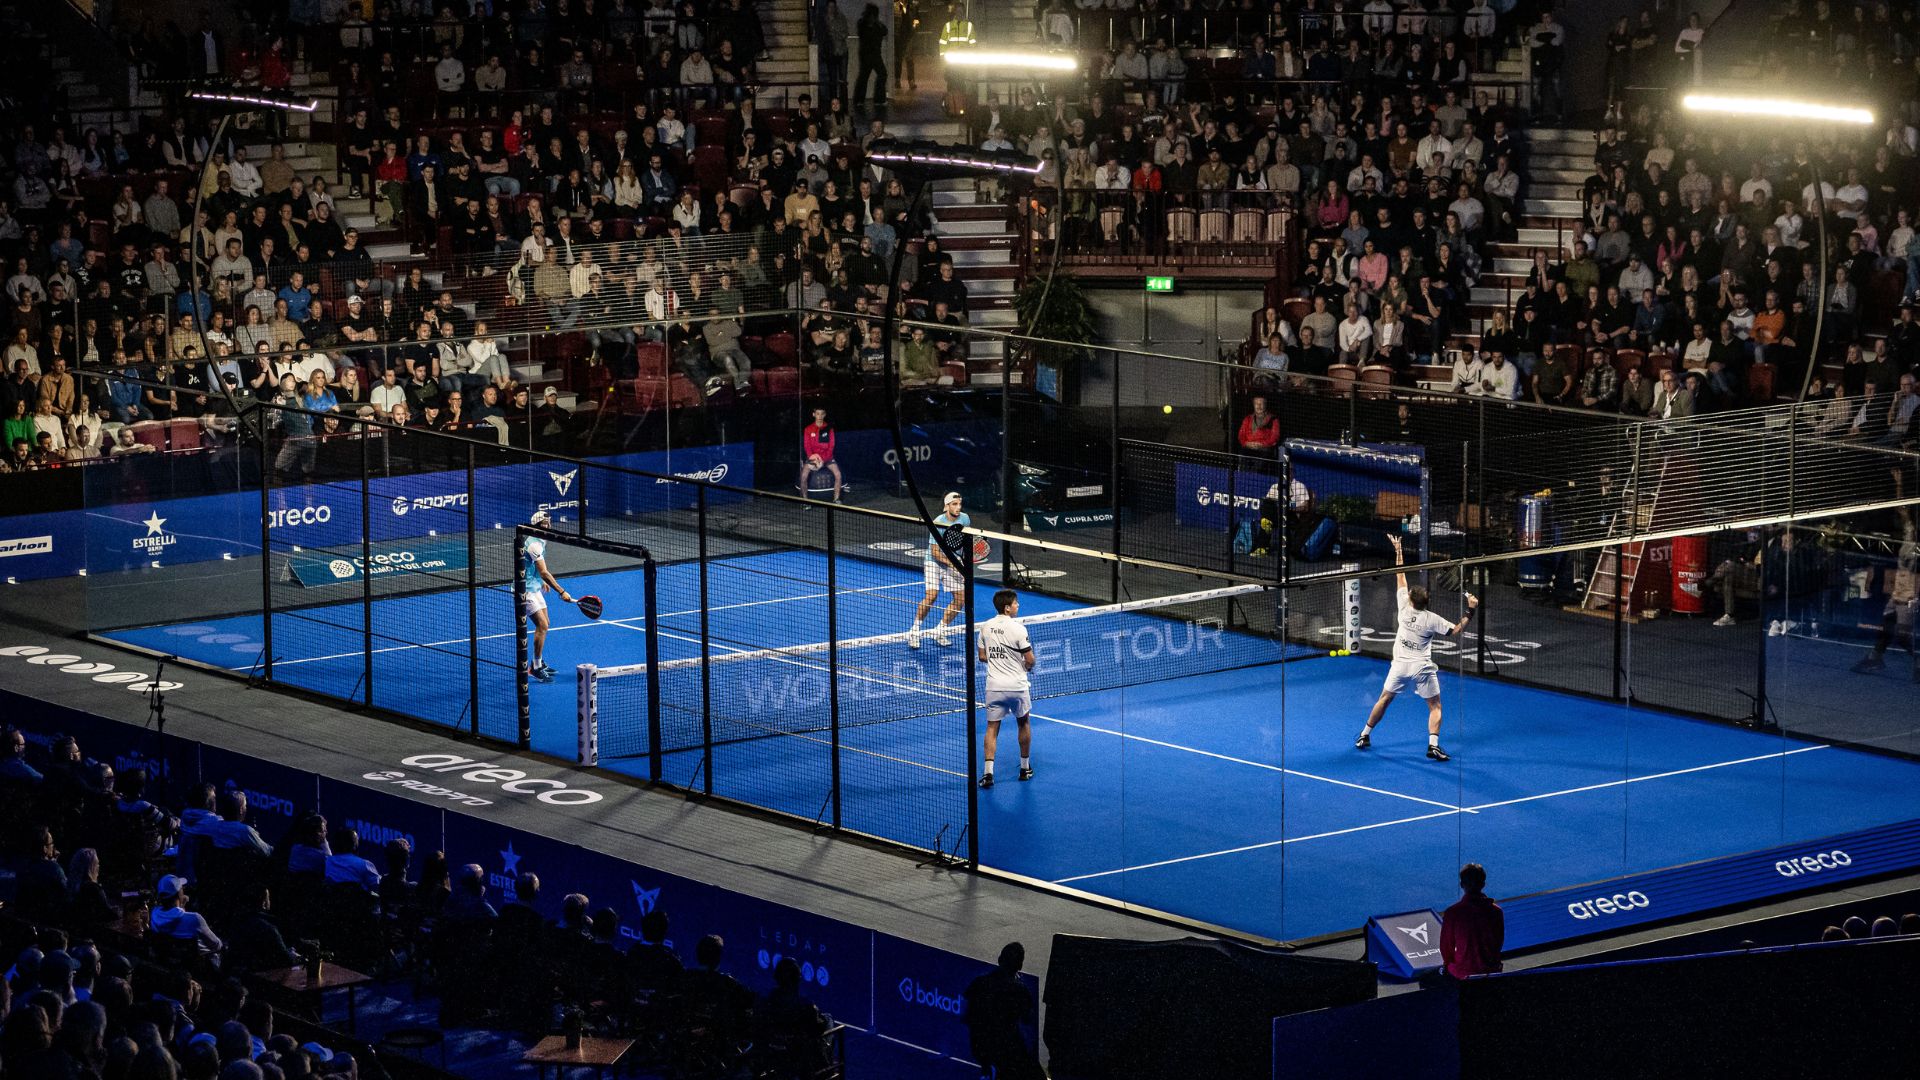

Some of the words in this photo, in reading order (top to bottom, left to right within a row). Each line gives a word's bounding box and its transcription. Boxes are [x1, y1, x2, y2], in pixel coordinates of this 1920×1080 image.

[1064, 516, 1092, 524] CUPRA
[0, 542, 48, 553] arlion
[132, 534, 177, 549] ESTRELLA
[1101, 615, 1225, 665] TOUR
[401, 754, 604, 805] areco
[1775, 850, 1852, 877] areco
[1567, 890, 1650, 919] areco
[1406, 948, 1441, 959] CUP
